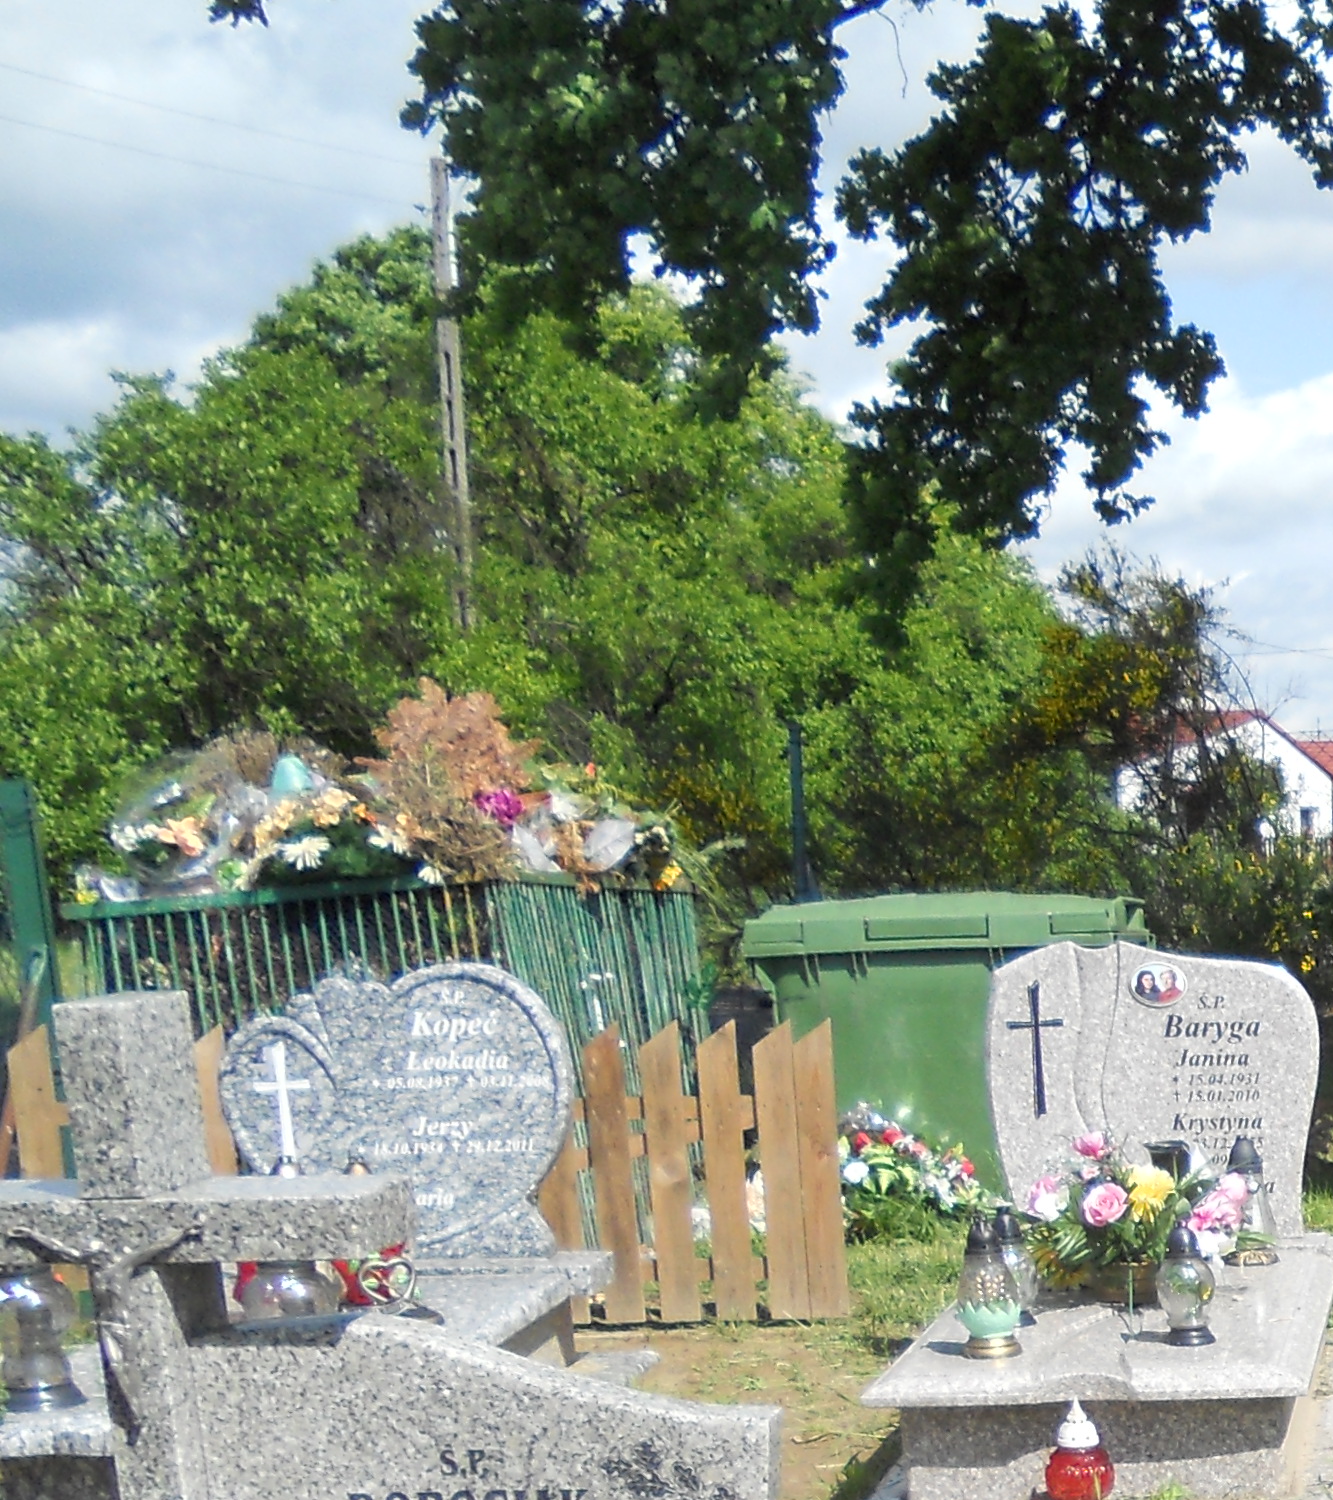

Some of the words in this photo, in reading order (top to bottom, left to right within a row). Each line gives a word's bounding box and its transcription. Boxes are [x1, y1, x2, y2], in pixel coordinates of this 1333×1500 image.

[411, 1010, 498, 1042] Kopeć
[1164, 1014, 1261, 1044] Baryga
[406, 1050, 509, 1071] Leokadia
[1176, 1048, 1250, 1067] Janina
[412, 1116, 474, 1140] Jerzy
[1172, 1113, 1263, 1135] Krystyna
[415, 1189, 455, 1207] aria
